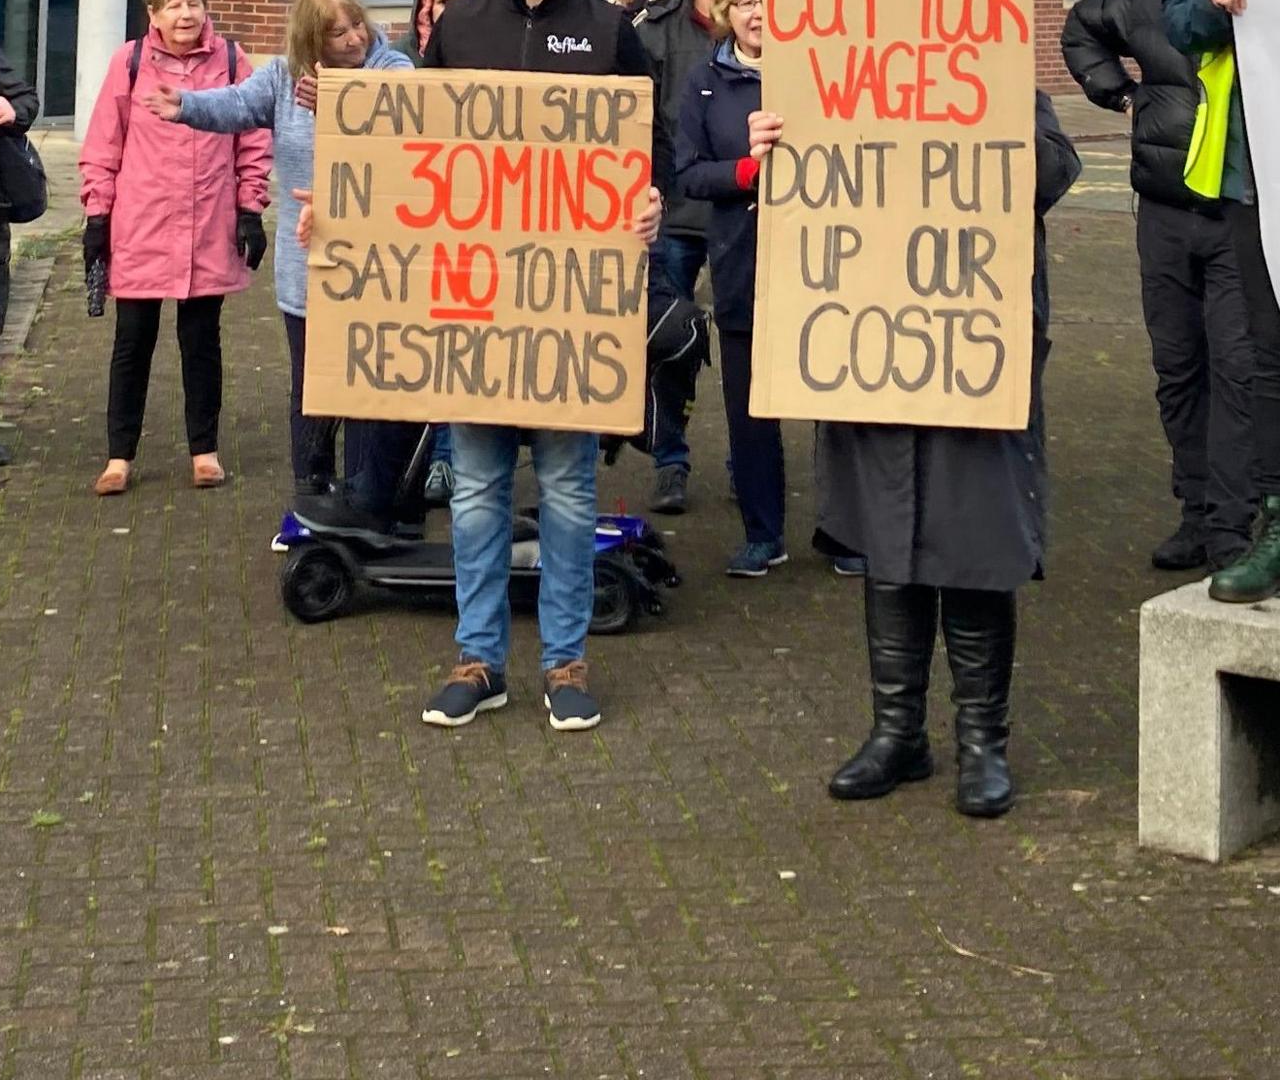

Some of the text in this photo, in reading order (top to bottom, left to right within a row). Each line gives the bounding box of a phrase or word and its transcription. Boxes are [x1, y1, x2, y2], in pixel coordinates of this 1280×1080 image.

[335, 80, 638, 146] CAN YOU SHOP
[809, 41, 988, 126] WAGES
[329, 162, 372, 218] IN
[922, 140, 1026, 213] PUT
[322, 240, 648, 317] SAY NO TO NEW
[800, 225, 1003, 301] UP OUR
[347, 322, 628, 405] RESTRICTIONS
[799, 302, 1006, 397] COSTS
